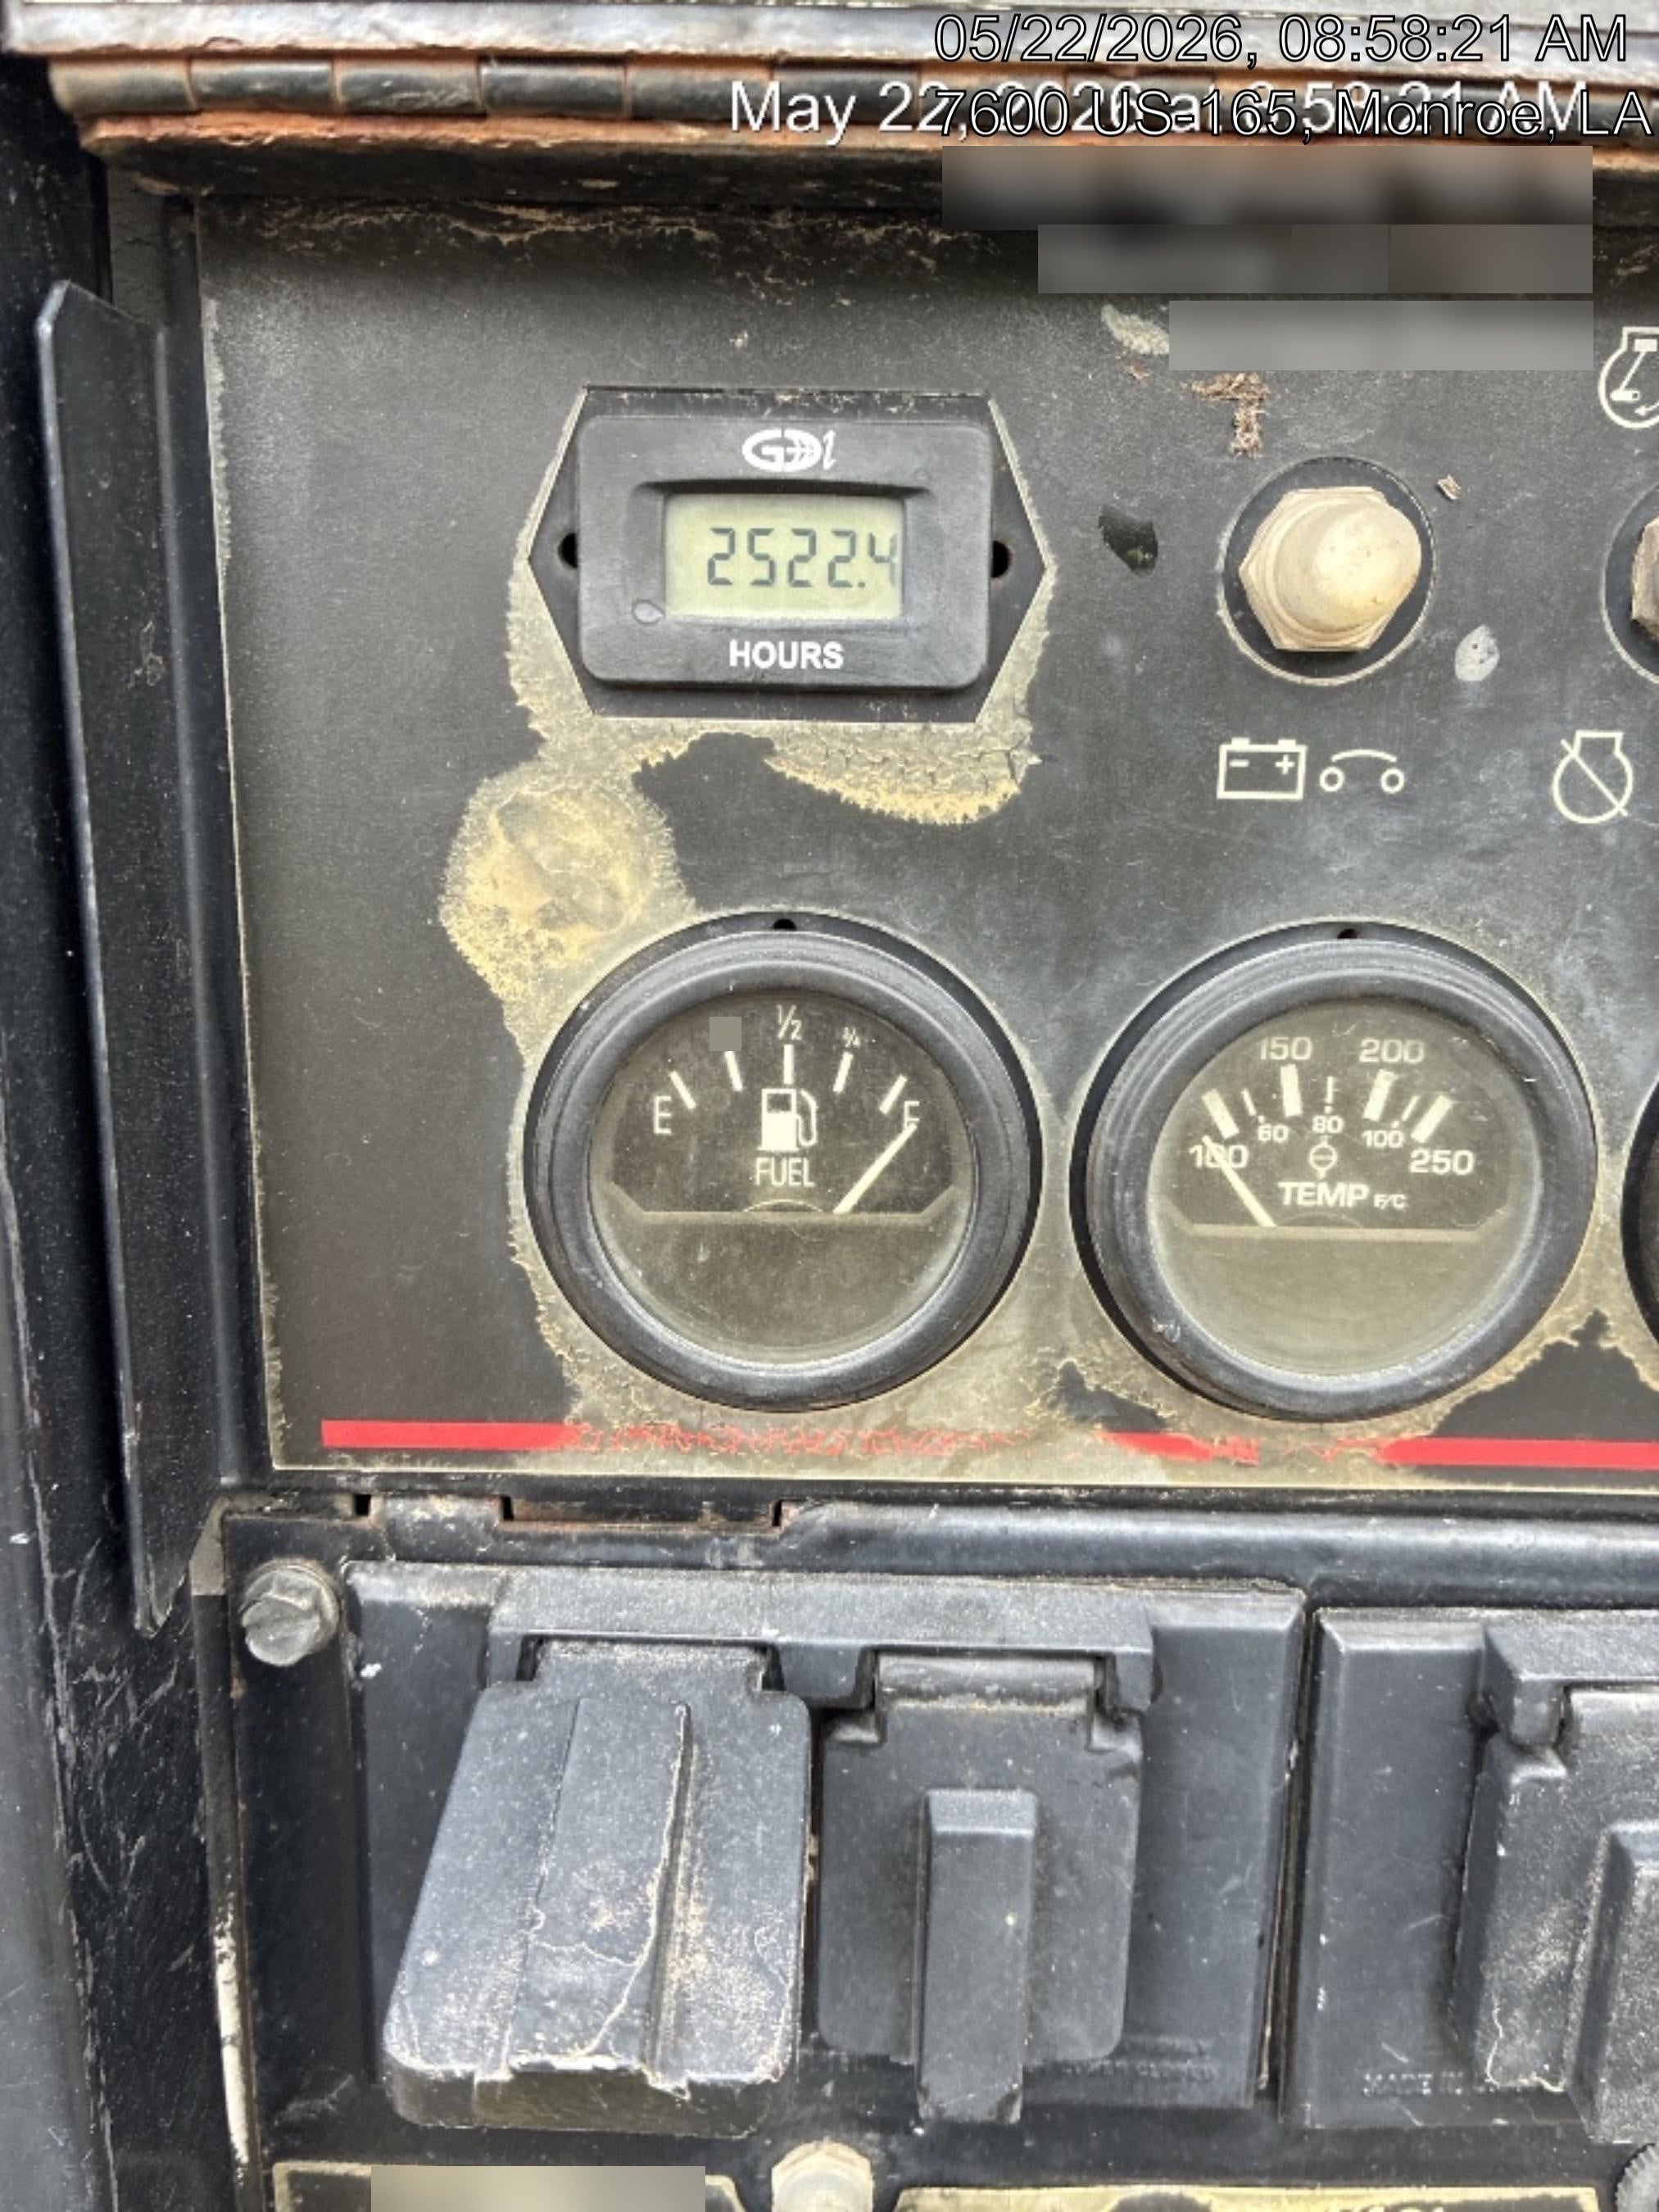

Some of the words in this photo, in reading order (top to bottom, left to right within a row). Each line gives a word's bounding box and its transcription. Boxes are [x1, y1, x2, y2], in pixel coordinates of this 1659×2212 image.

[707, 528, 899, 587] 2522.4
[729, 641, 845, 669] HOURS
[1260, 1036, 1313, 1061] 150
[1358, 1037, 1425, 1064] 200
[654, 1095, 673, 1135] E
[904, 1100, 920, 1132] F
[1312, 1115, 1344, 1134] 80
[1362, 1129, 1404, 1149] 100
[755, 1157, 815, 1188] FUEL
[1408, 1149, 1475, 1176] 250
[1278, 1181, 1370, 1207] TEMP
[1373, 1193, 1409, 1211] F/C
